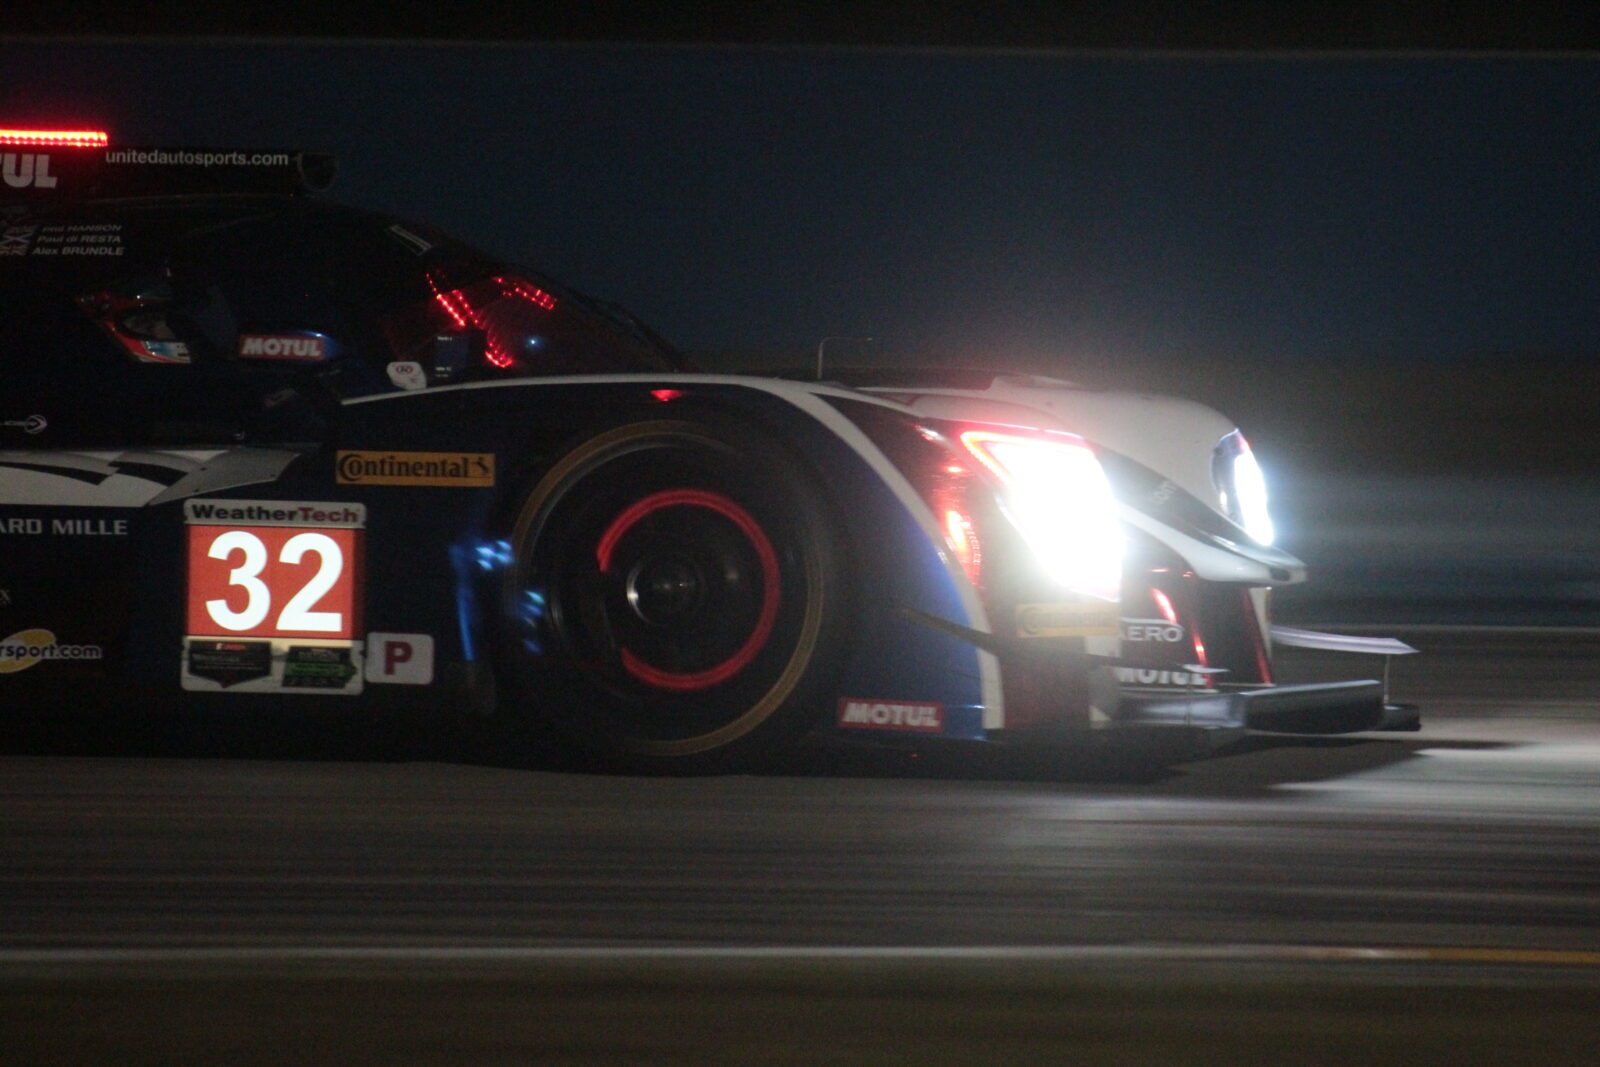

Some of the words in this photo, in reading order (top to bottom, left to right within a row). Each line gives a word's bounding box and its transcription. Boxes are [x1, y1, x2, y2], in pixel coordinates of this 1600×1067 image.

[105, 150, 289, 167] unitedautosports.com
[0, 153, 58, 188] UL
[67, 224, 122, 232] HANSON
[80, 235, 121, 243] RESTA
[32, 247, 58, 255] Alex
[62, 247, 125, 256] BRUNDLE
[242, 338, 321, 356] MOTUL
[338, 454, 468, 481] Continental
[191, 503, 359, 523] WeatherTech
[52, 519, 128, 535] MILLE
[205, 530, 344, 632] 32
[1118, 624, 1183, 642] ERO
[384, 641, 412, 675] P
[842, 702, 940, 727] MOTUL
